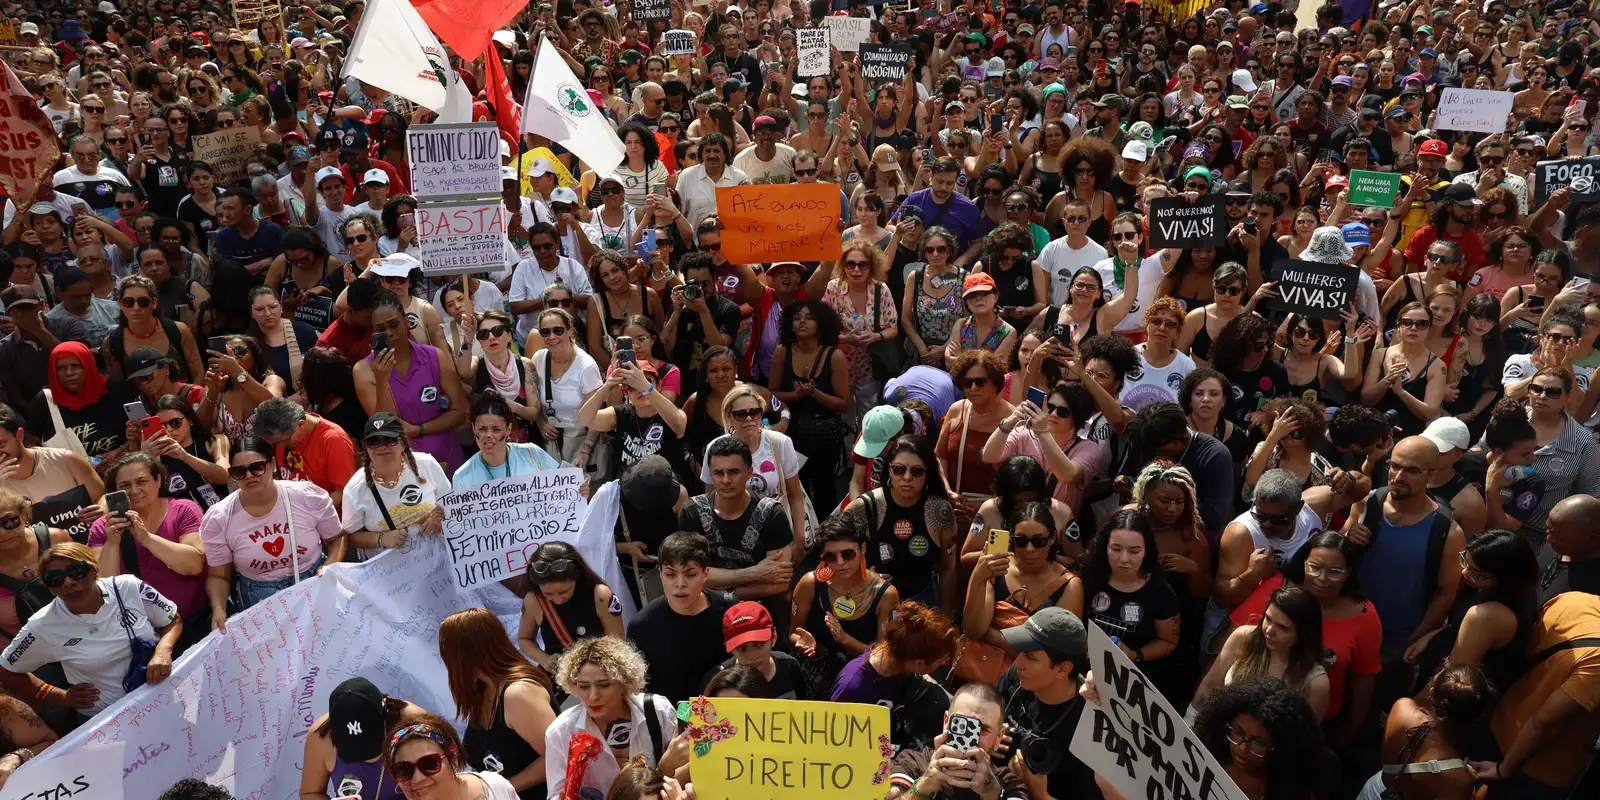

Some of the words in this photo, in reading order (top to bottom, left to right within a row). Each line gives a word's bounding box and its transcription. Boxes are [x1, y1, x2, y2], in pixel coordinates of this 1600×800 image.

[828, 18, 865, 31] BRASIL
[800, 31, 815, 39] PARE
[800, 37, 826, 46] MATAR
[836, 31, 855, 40] SEM
[665, 39, 694, 52] MATA
[799, 43, 828, 52] MULHERES
[863, 50, 908, 63] CRIMINALIZAÇÃO
[861, 63, 906, 79] MISOGINIA
[214, 134, 231, 145] VAI
[234, 131, 248, 142] SE
[408, 128, 499, 164] FEMINICÍDIO
[200, 144, 246, 161] ARREPENDER
[248, 141, 260, 150] DE
[422, 166, 447, 176] CAÇA
[468, 162, 499, 172] BRUXAS
[1545, 163, 1593, 184] FOGO
[1357, 177, 1375, 185] NEM
[1375, 178, 1391, 187] UMA
[1362, 187, 1391, 195] MENOS!
[732, 193, 764, 213] ATÉ
[770, 199, 828, 213] QUANDO
[1156, 208, 1174, 220] NOS
[1176, 204, 1216, 219] QUEREMOS
[418, 206, 507, 237] BASTA!
[776, 221, 806, 233] NOS
[1158, 215, 1215, 242] VIVAS!
[749, 235, 811, 253] MATAR
[421, 255, 479, 270] MULHERES
[1280, 269, 1346, 289] MULHERES
[1278, 285, 1347, 310] VIVAS!
[248, 522, 291, 543] MAKE
[562, 513, 580, 533] É
[455, 558, 502, 588] UMA
[6, 632, 37, 667] NETSHOES
[1103, 648, 1176, 748] NÃO
[744, 710, 873, 751] NENHUM
[1092, 708, 1139, 779] POR
[724, 753, 855, 791] DIREITO
